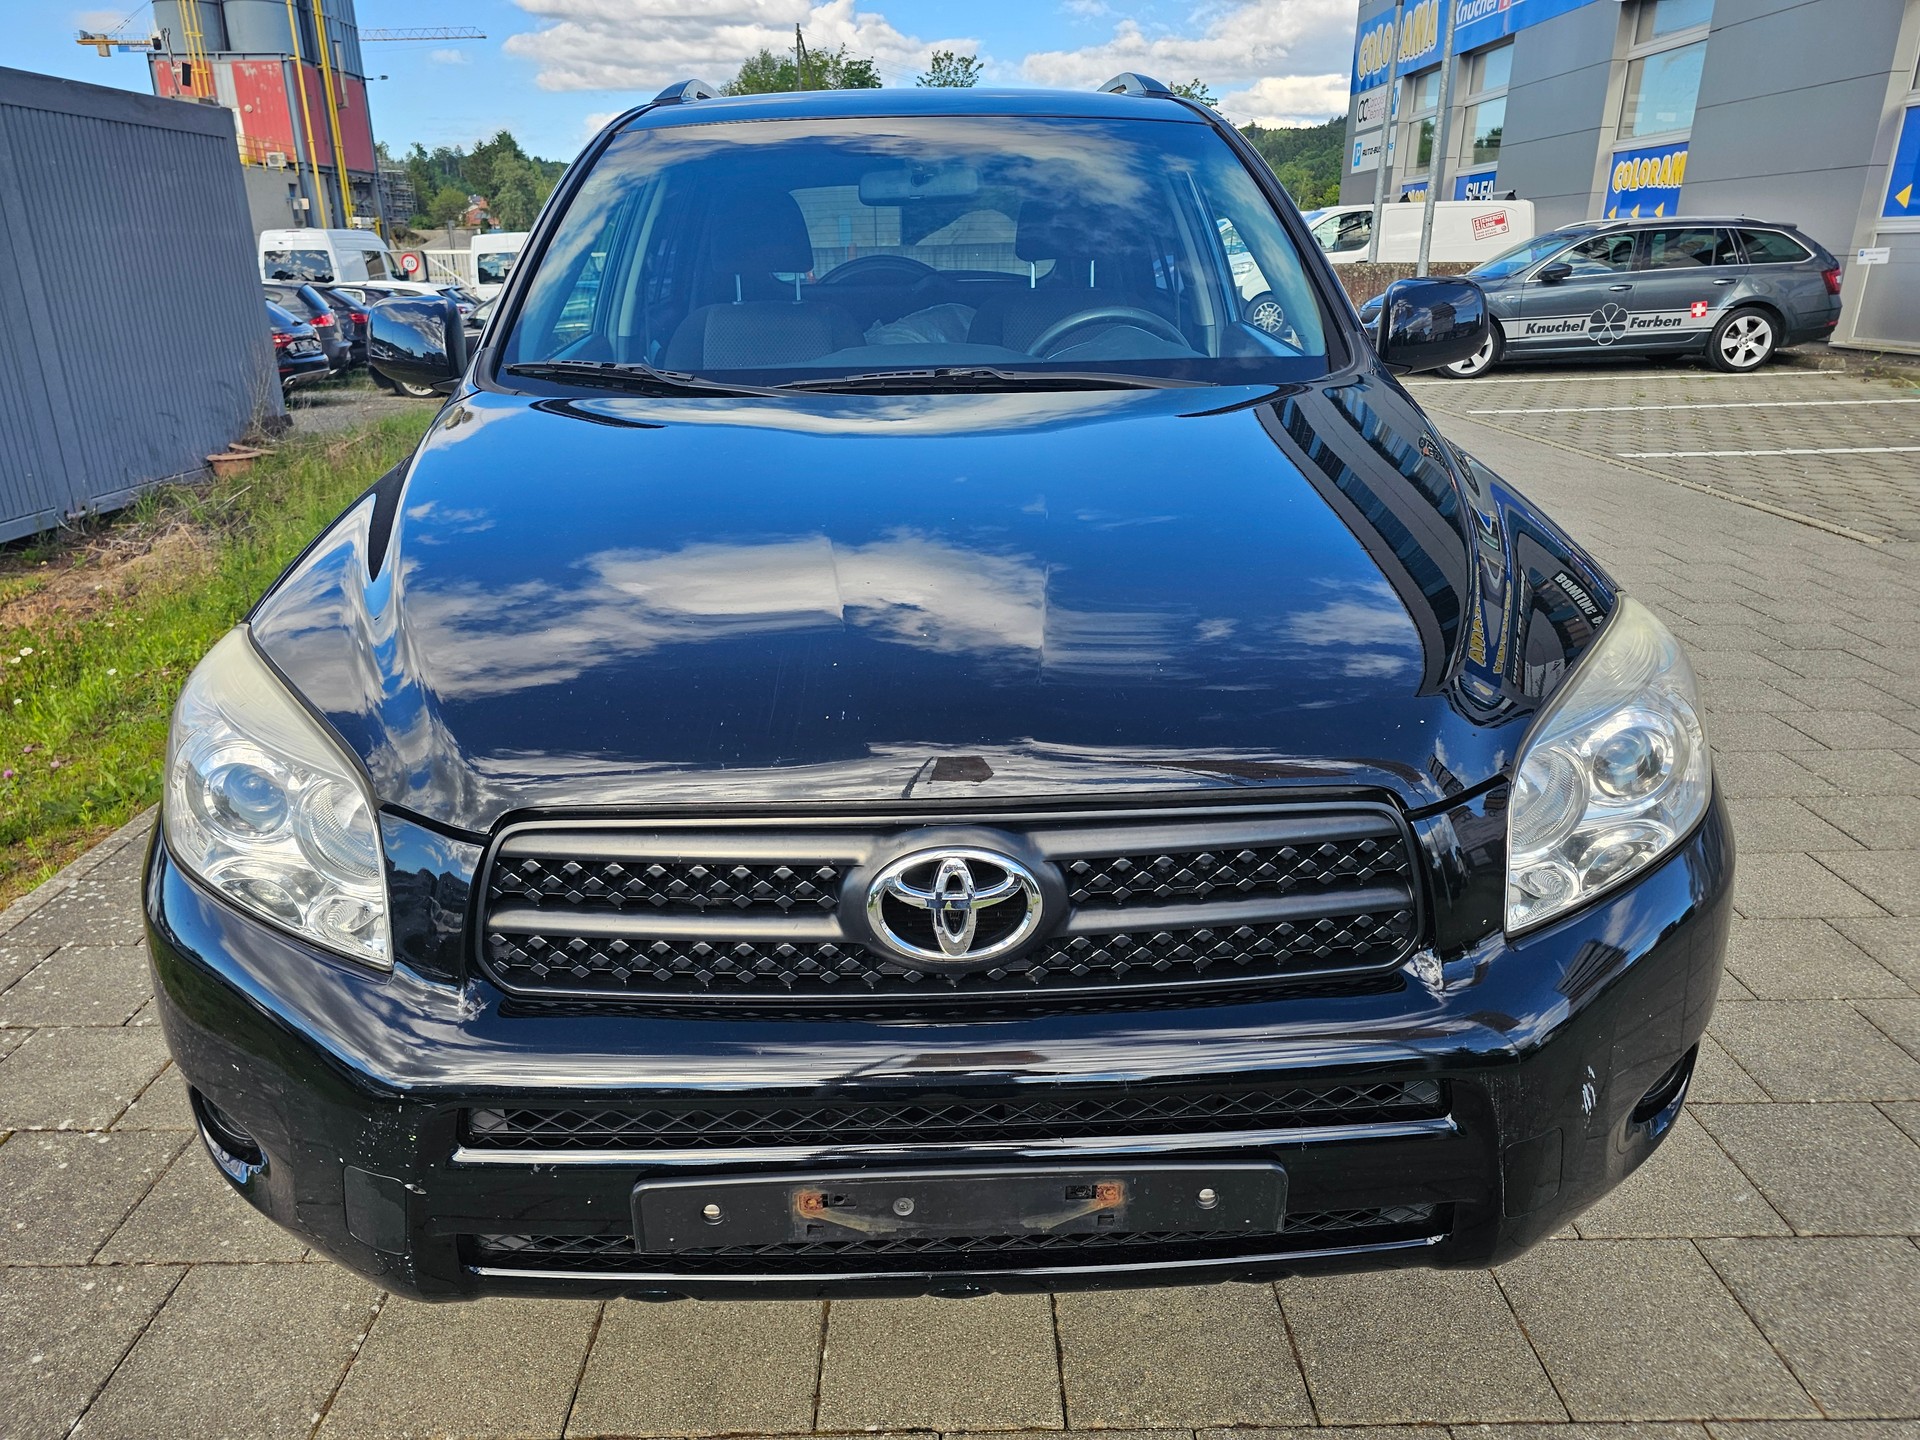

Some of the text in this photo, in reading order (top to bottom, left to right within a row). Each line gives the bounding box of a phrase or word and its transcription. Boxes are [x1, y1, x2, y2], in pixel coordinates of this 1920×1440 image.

[1358, 1, 1439, 81] COLOAMA
[1612, 151, 1688, 194] COLORAM
[1525, 316, 1682, 334] Knuchel Farben
